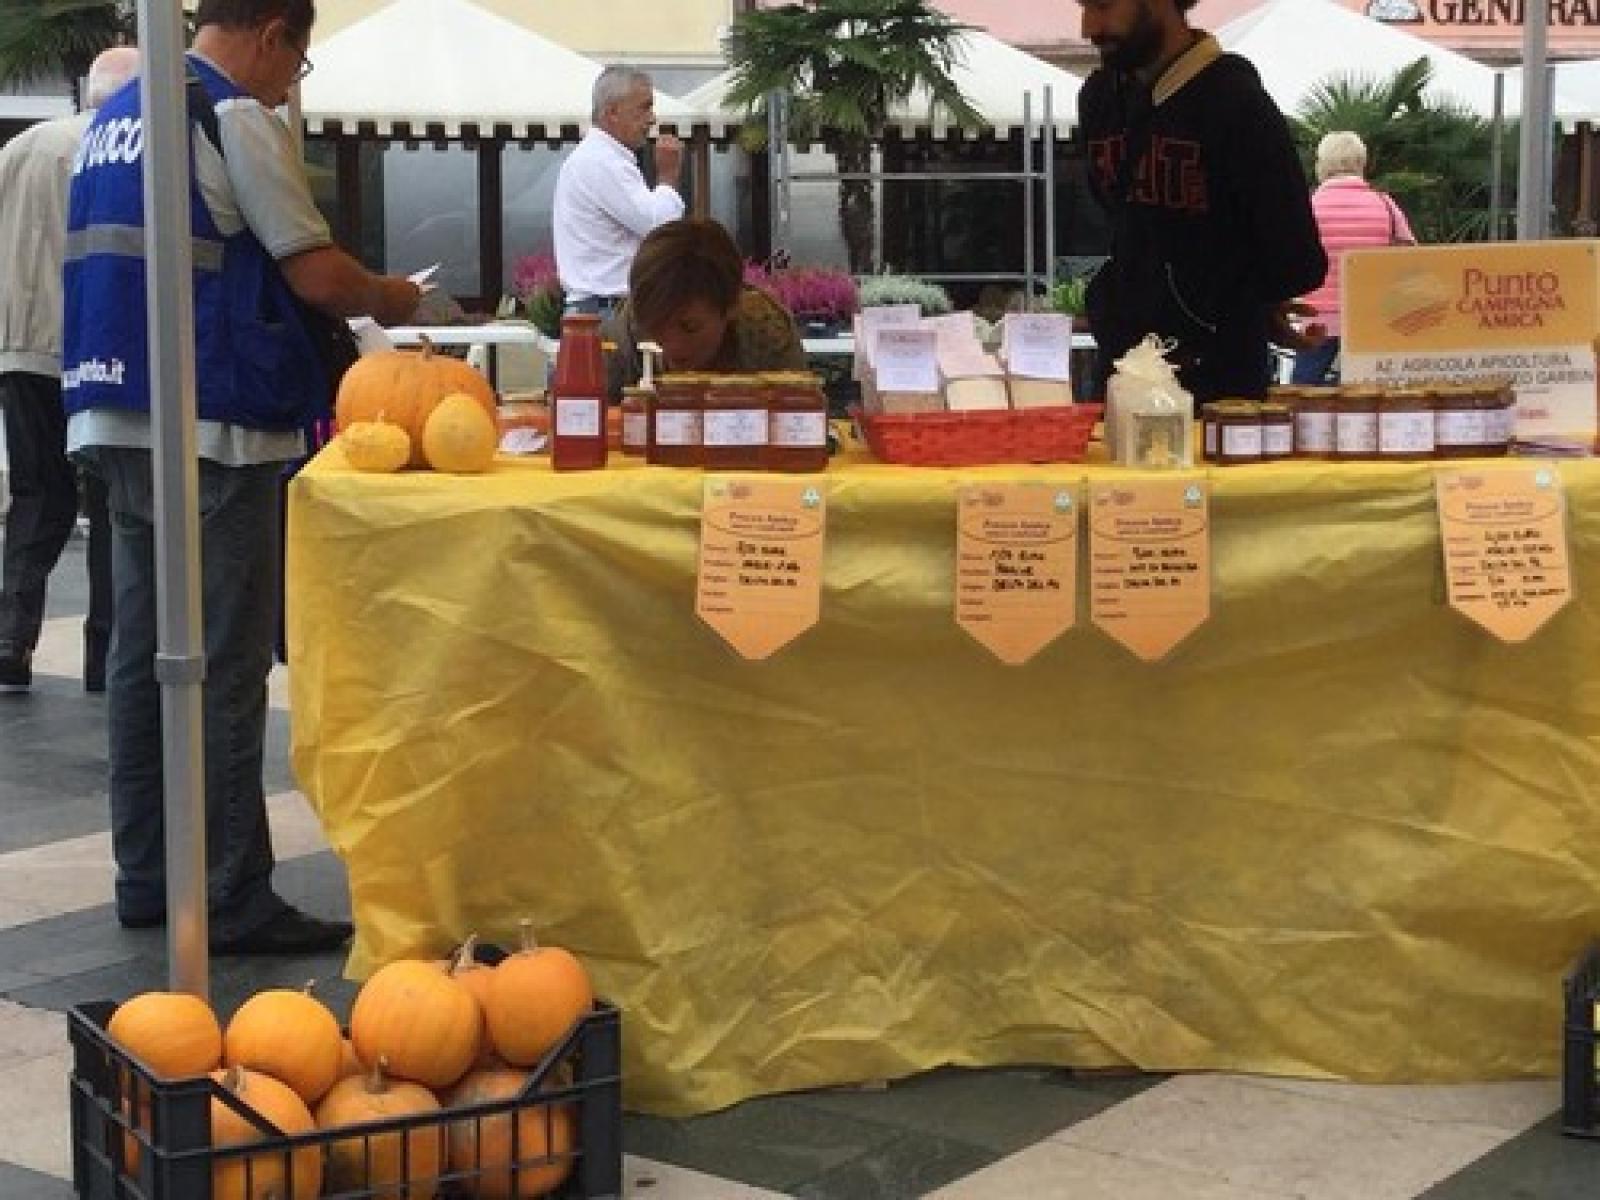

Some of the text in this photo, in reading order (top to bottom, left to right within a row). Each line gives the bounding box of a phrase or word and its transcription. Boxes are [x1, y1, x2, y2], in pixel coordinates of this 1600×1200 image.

[1463, 267, 1560, 297] Punto
[1456, 296, 1565, 314] CAMPAGNA
[1478, 312, 1543, 329] AMICA
[1402, 356, 1476, 370] AGRICOLA
[1479, 353, 1572, 369] APICOLTURA
